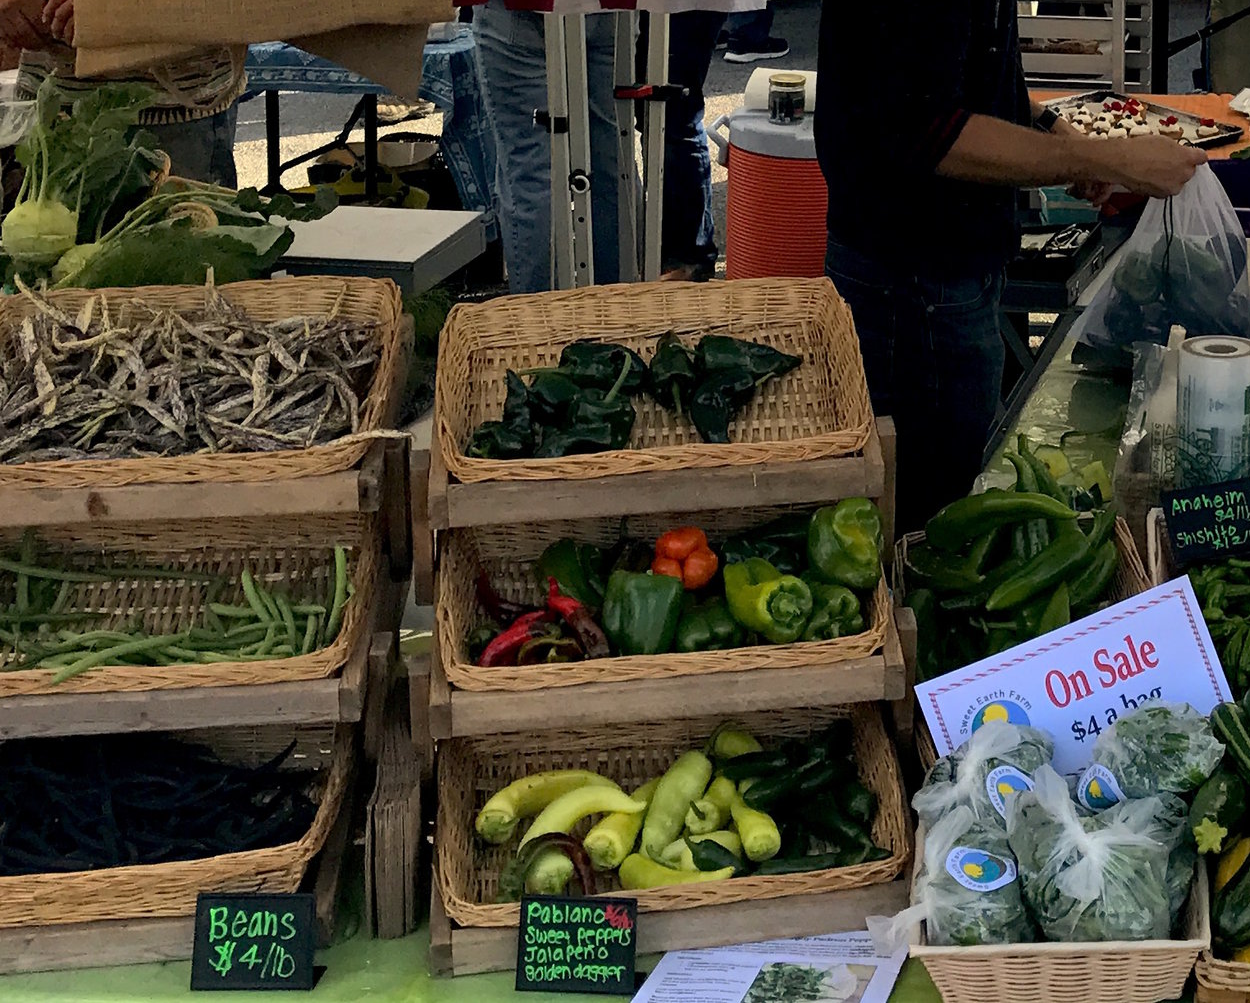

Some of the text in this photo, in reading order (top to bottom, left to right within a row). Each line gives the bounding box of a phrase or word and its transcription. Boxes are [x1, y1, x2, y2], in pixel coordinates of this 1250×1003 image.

[1172, 490, 1247, 516] Anaheim
[1176, 524, 1237, 548] Shishito
[1044, 634, 1160, 709] On Sale
[959, 689, 1032, 735] Sweet Earth Farm
[1071, 715, 1102, 743] $4
[1104, 707, 1118, 726] a
[208, 906, 297, 943] Beans
[527, 901, 606, 924] Pablano
[525, 925, 571, 944] Sweet
